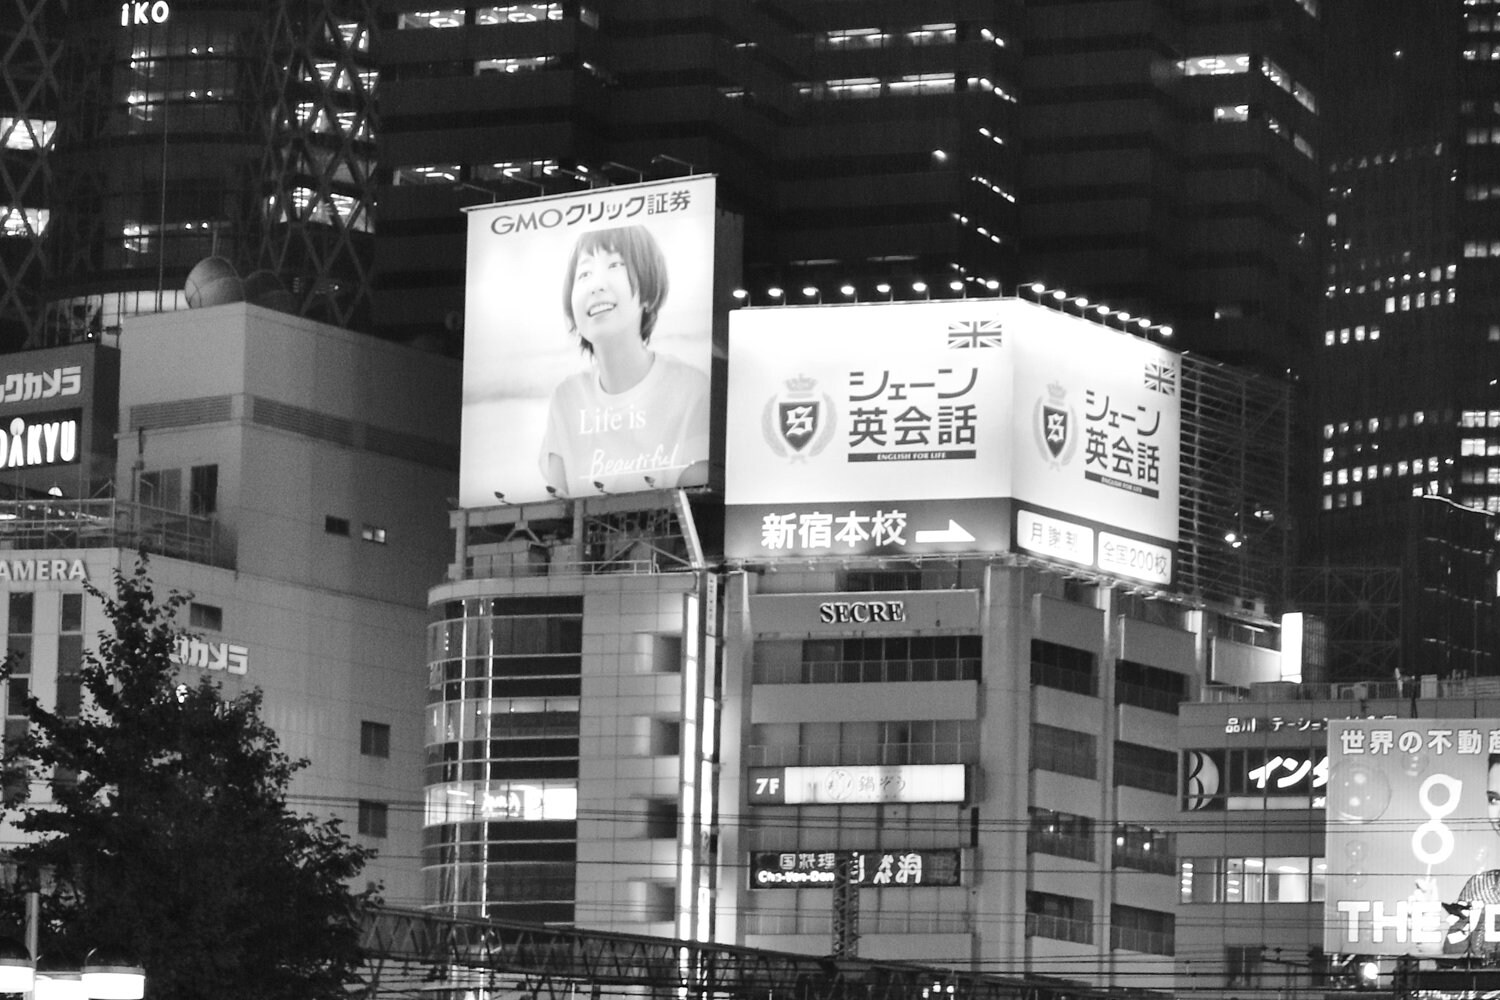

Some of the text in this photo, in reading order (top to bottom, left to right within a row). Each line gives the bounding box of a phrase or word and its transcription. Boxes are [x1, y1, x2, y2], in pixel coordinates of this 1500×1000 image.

[491, 190, 691, 235] GMOクリック証券
[0, 365, 82, 404] クカメラ
[849, 368, 978, 402] シェーン
[578, 404, 647, 435] Life is
[849, 404, 978, 447] 英会話
[1085, 389, 1161, 437] シェーン
[877, 451, 947, 461] ENGLISH FOR LIFE
[1085, 426, 1161, 485] 英会話
[761, 510, 907, 550] 新宿本校
[1103, 540, 1168, 578] 全国200校
[819, 601, 907, 624] SECRE
[755, 778, 780, 795] 7F
